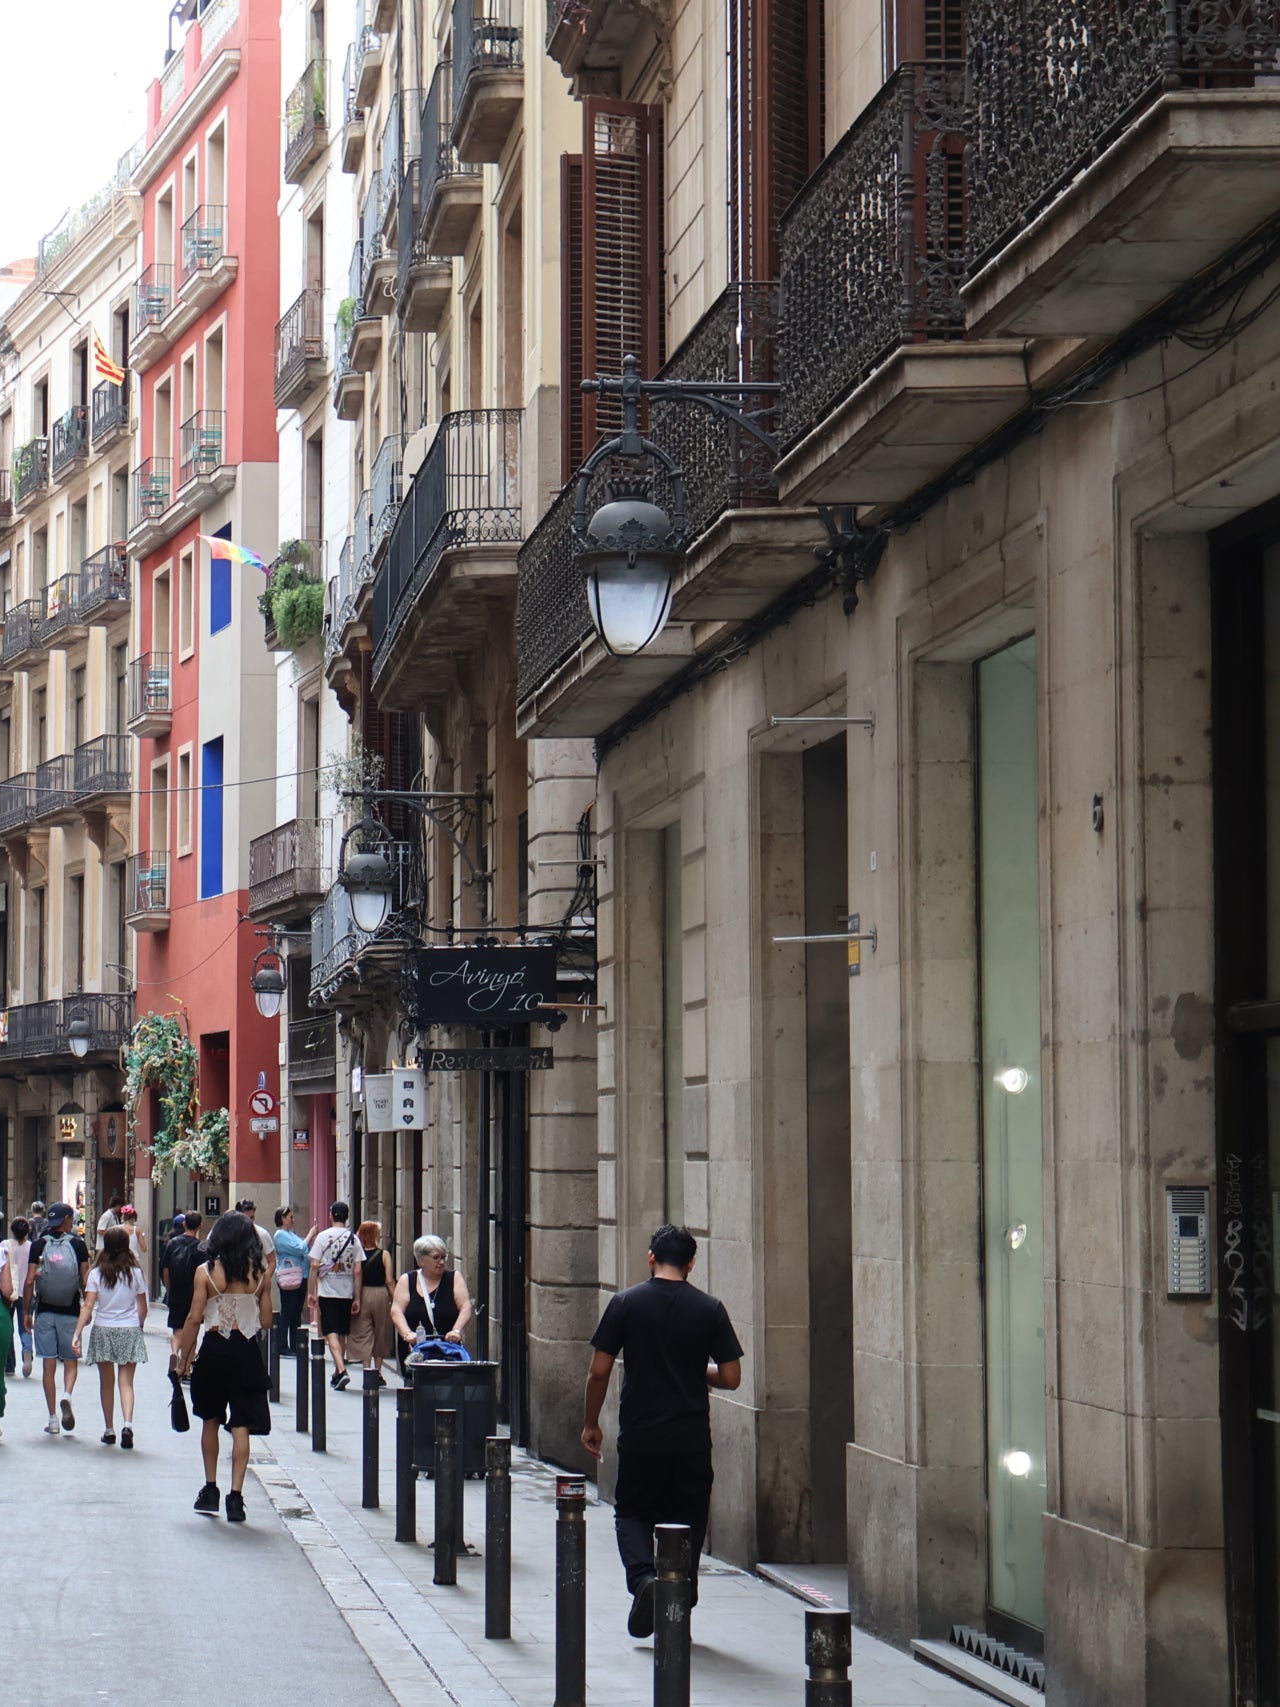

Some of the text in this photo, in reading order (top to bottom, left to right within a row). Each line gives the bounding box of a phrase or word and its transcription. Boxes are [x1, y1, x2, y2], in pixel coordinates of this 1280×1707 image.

[429, 960, 526, 1011] Avinyó
[508, 993, 543, 1010] 10
[429, 1050, 549, 1071] Restaant
[209, 1198, 217, 1210] H
